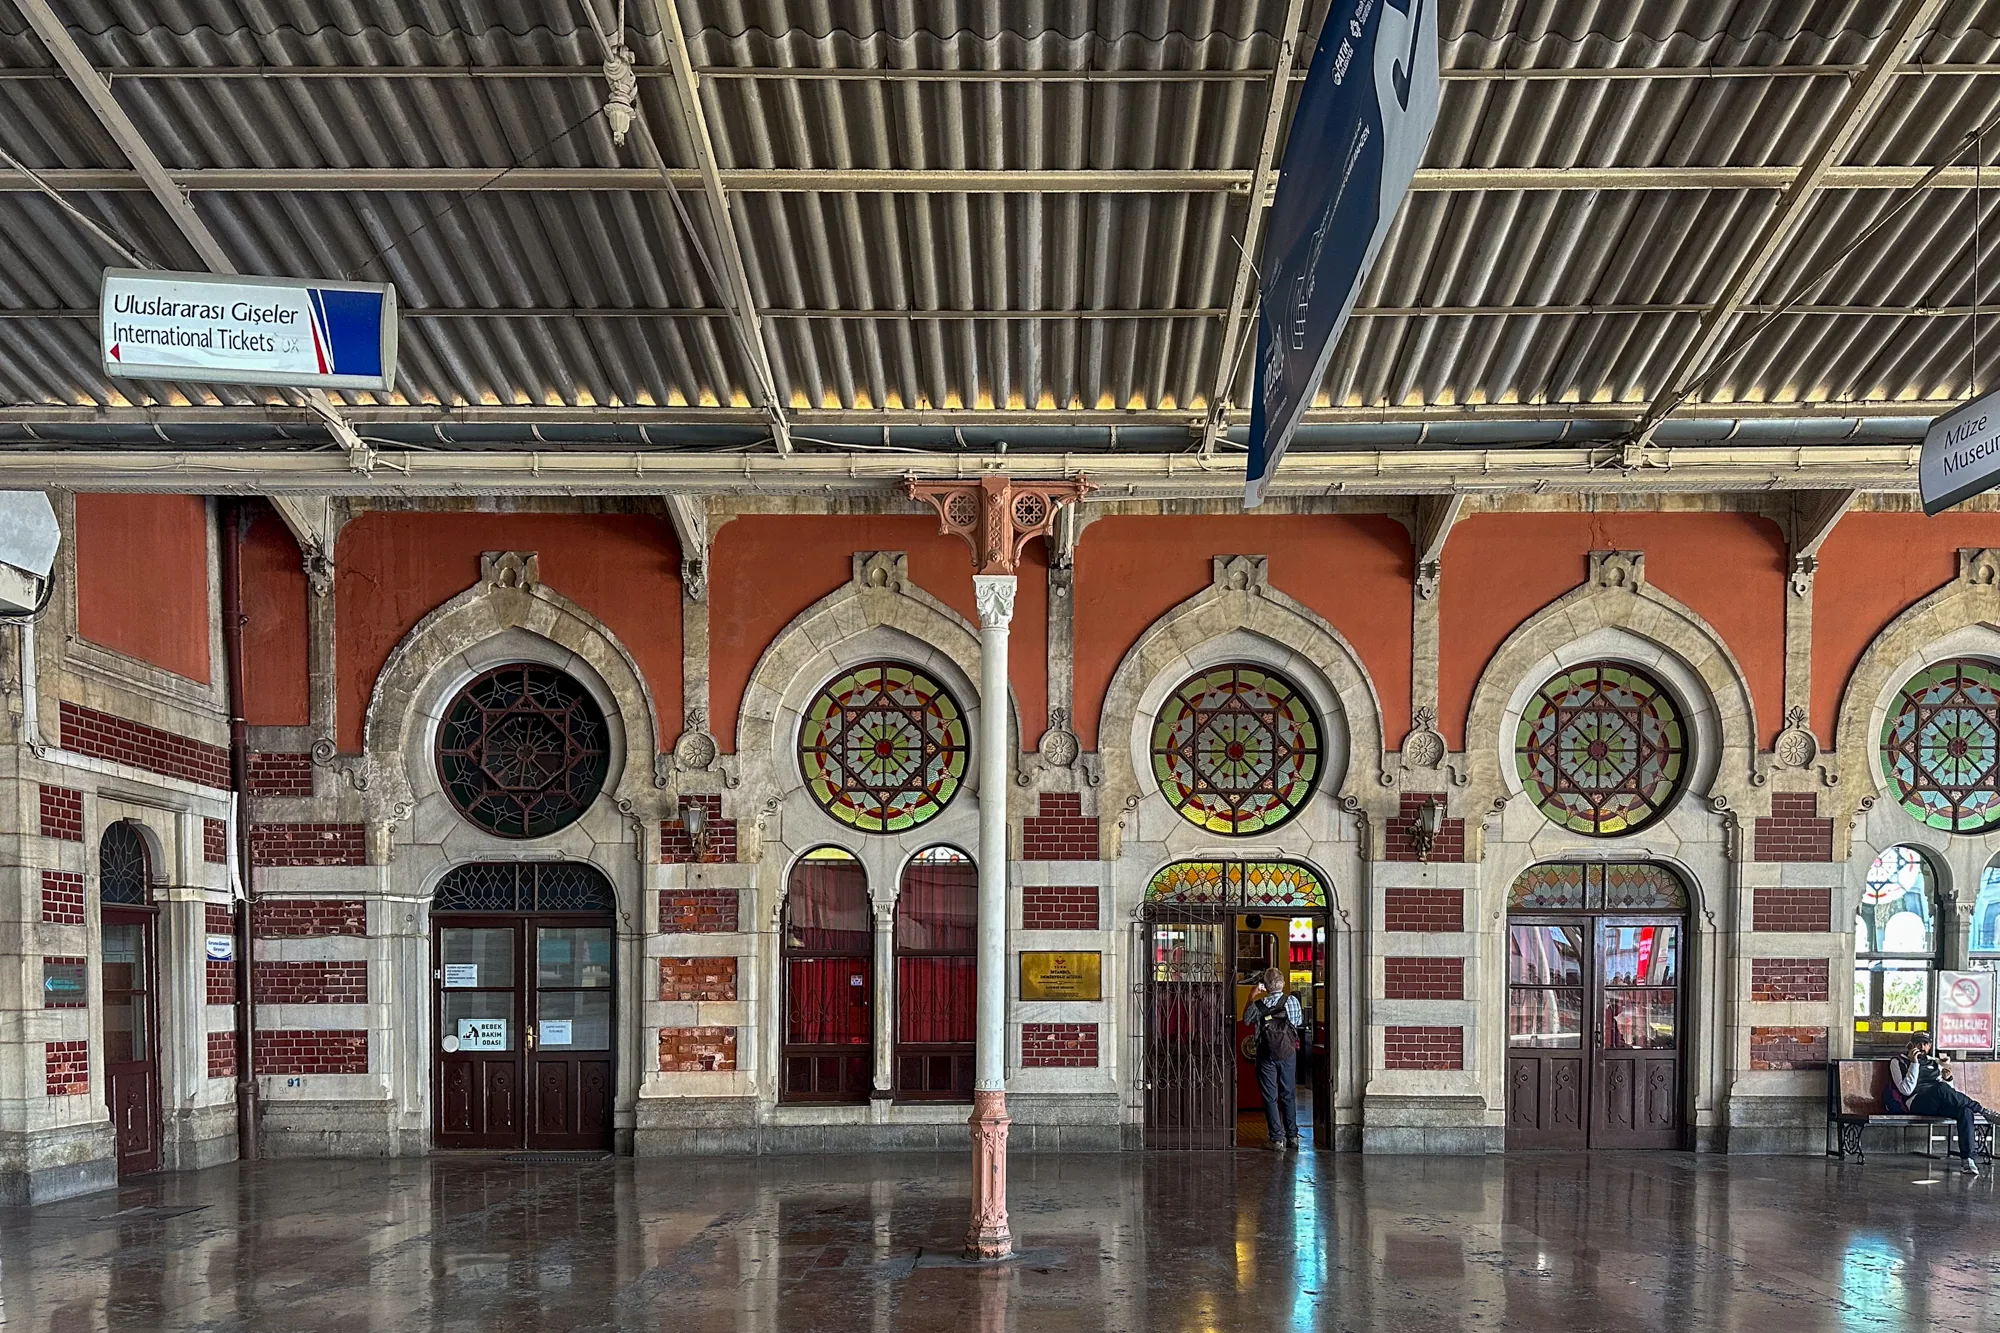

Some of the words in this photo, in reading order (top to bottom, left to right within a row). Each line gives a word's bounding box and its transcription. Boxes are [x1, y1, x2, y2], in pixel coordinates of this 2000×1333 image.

[114, 294, 225, 320] Uluslararası
[231, 302, 299, 325] Gişeler
[113, 322, 213, 348] International
[218, 329, 274, 352] Tickets
[1944, 415, 1987, 449] Müze
[287, 1077, 300, 1088] 91
